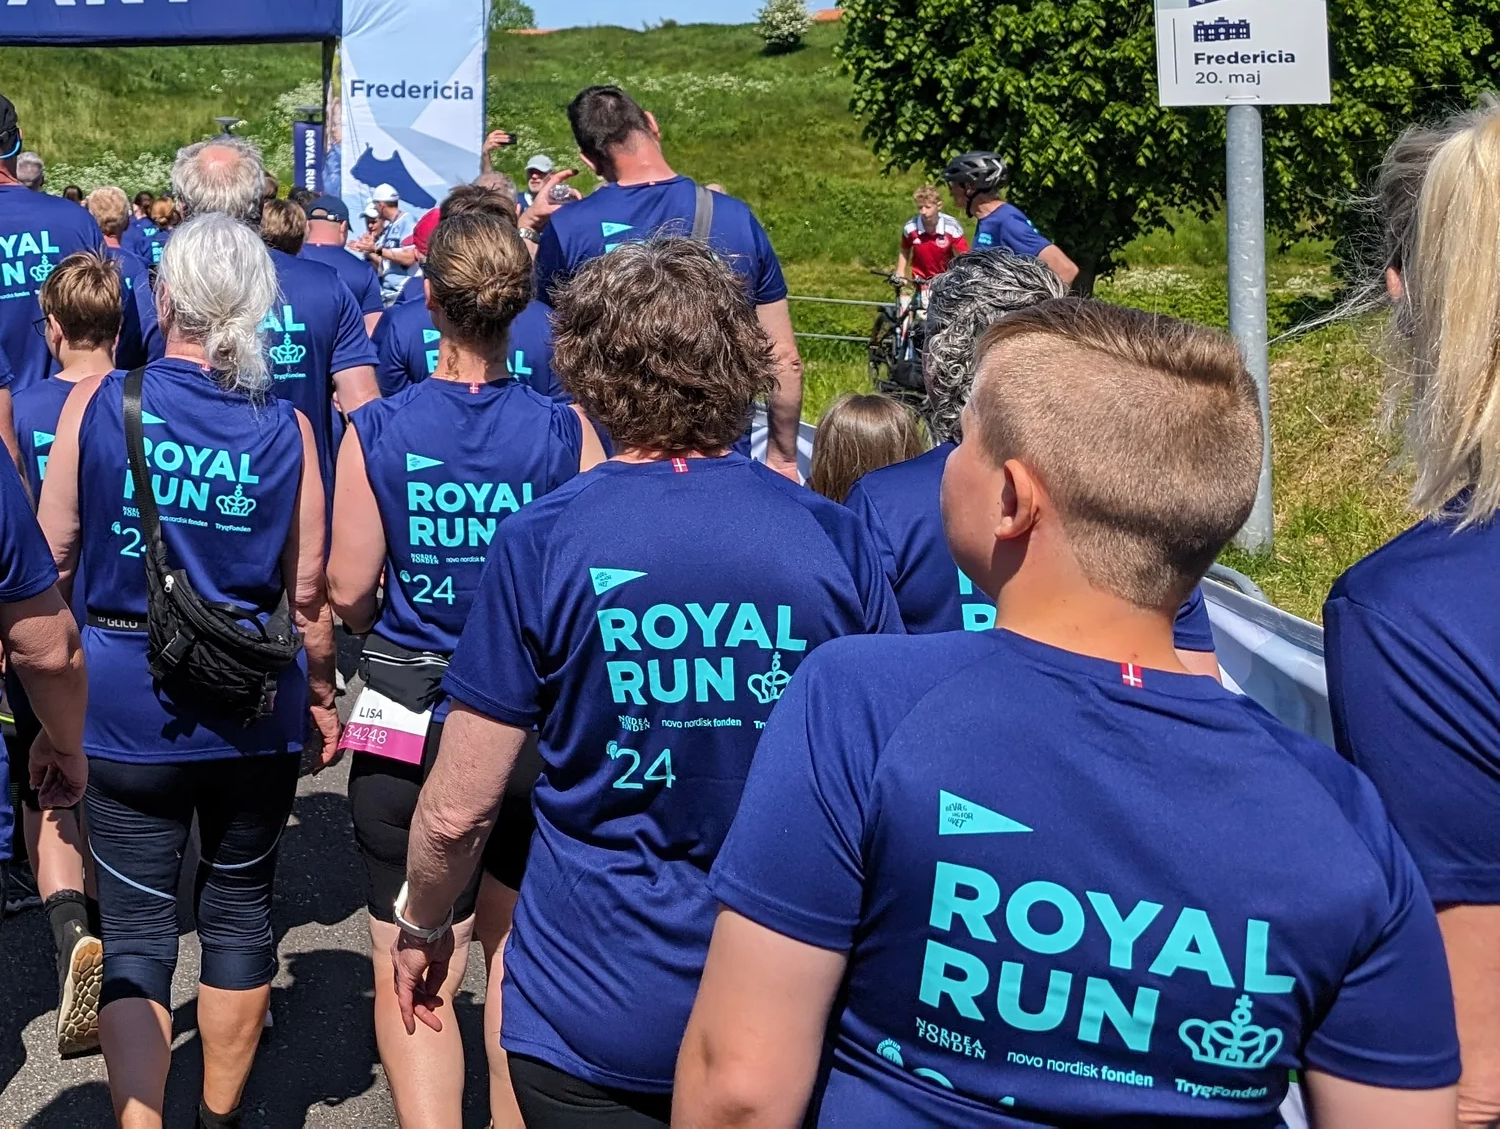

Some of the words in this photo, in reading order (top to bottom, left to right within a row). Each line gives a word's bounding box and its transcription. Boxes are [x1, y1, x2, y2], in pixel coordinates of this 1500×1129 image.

[1193, 49, 1297, 66] Fredericia
[350, 78, 475, 100] Fredericia
[1194, 71, 1224, 85] 20.
[1228, 69, 1261, 86] maj
[305, 129, 317, 168] ROYAL
[409, 516, 497, 548] RUN
[597, 602, 808, 652] ROYAL
[606, 656, 736, 706] RUN
[359, 706, 383, 720] LISA
[661, 719, 683, 729] novo
[684, 718, 713, 729] nordisk
[713, 717, 742, 728] fonden
[345, 724, 388, 745] 34248
[928, 860, 1297, 994] ROYAL
[918, 938, 1161, 1053] RUN
[915, 1016, 983, 1050] NORDEA
[918, 1028, 987, 1060] FONDEN
[1007, 1051, 1043, 1068] novo
[1046, 1058, 1099, 1079] nordisk
[1101, 1065, 1154, 1088] fonden
[1175, 1078, 1268, 1100] TrygFonden
